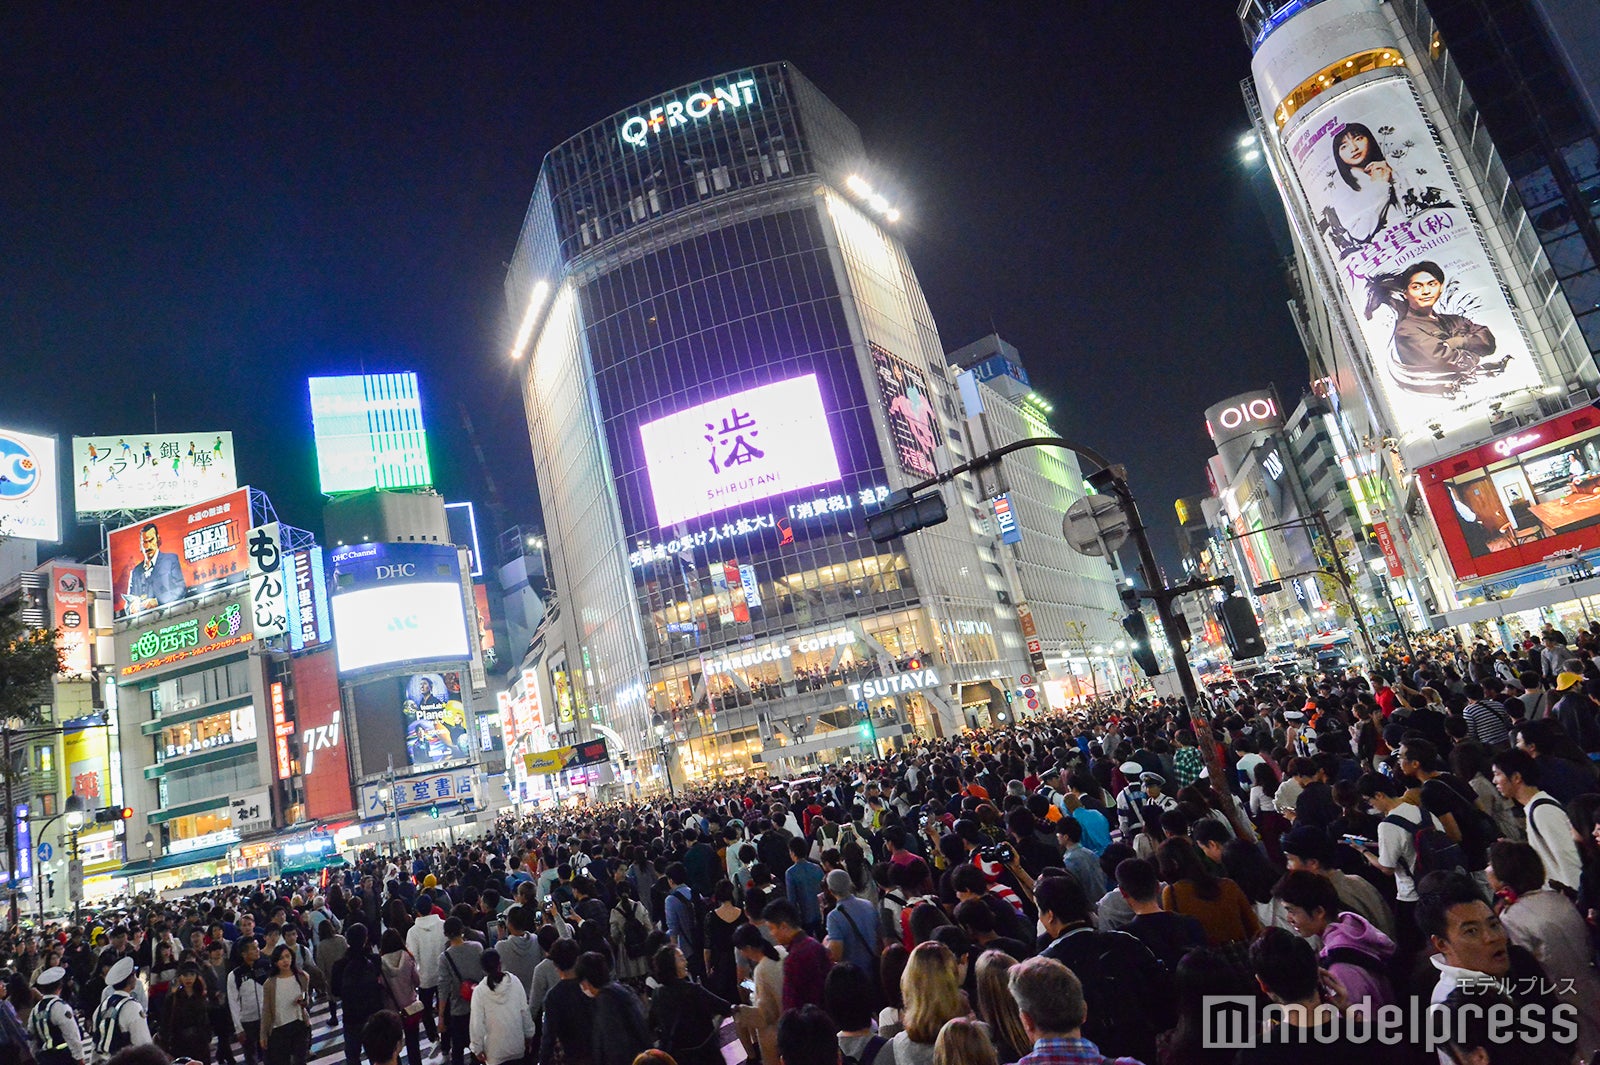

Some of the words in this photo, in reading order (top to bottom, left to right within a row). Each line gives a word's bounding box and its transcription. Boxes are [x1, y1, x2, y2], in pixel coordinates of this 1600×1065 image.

[621, 79, 754, 147] QFRONT
[703, 407, 765, 475] 渋
[707, 471, 781, 500] SHIBUTANI
[332, 551, 348, 562] DHC
[348, 548, 377, 561] Channel
[375, 562, 417, 581] DHC
[248, 528, 287, 632] もんじゃ
[294, 553, 317, 643] 三千里薬品
[160, 627, 199, 653] 西村
[705, 644, 791, 676] STARBUCKS
[798, 631, 857, 654] COFFEE
[848, 669, 939, 701] TSUTAYA
[416, 709, 452, 721] Planets
[166, 733, 231, 757] Euphoria
[303, 710, 340, 775] クスリ
[369, 775, 471, 810] 大盛堂書店
